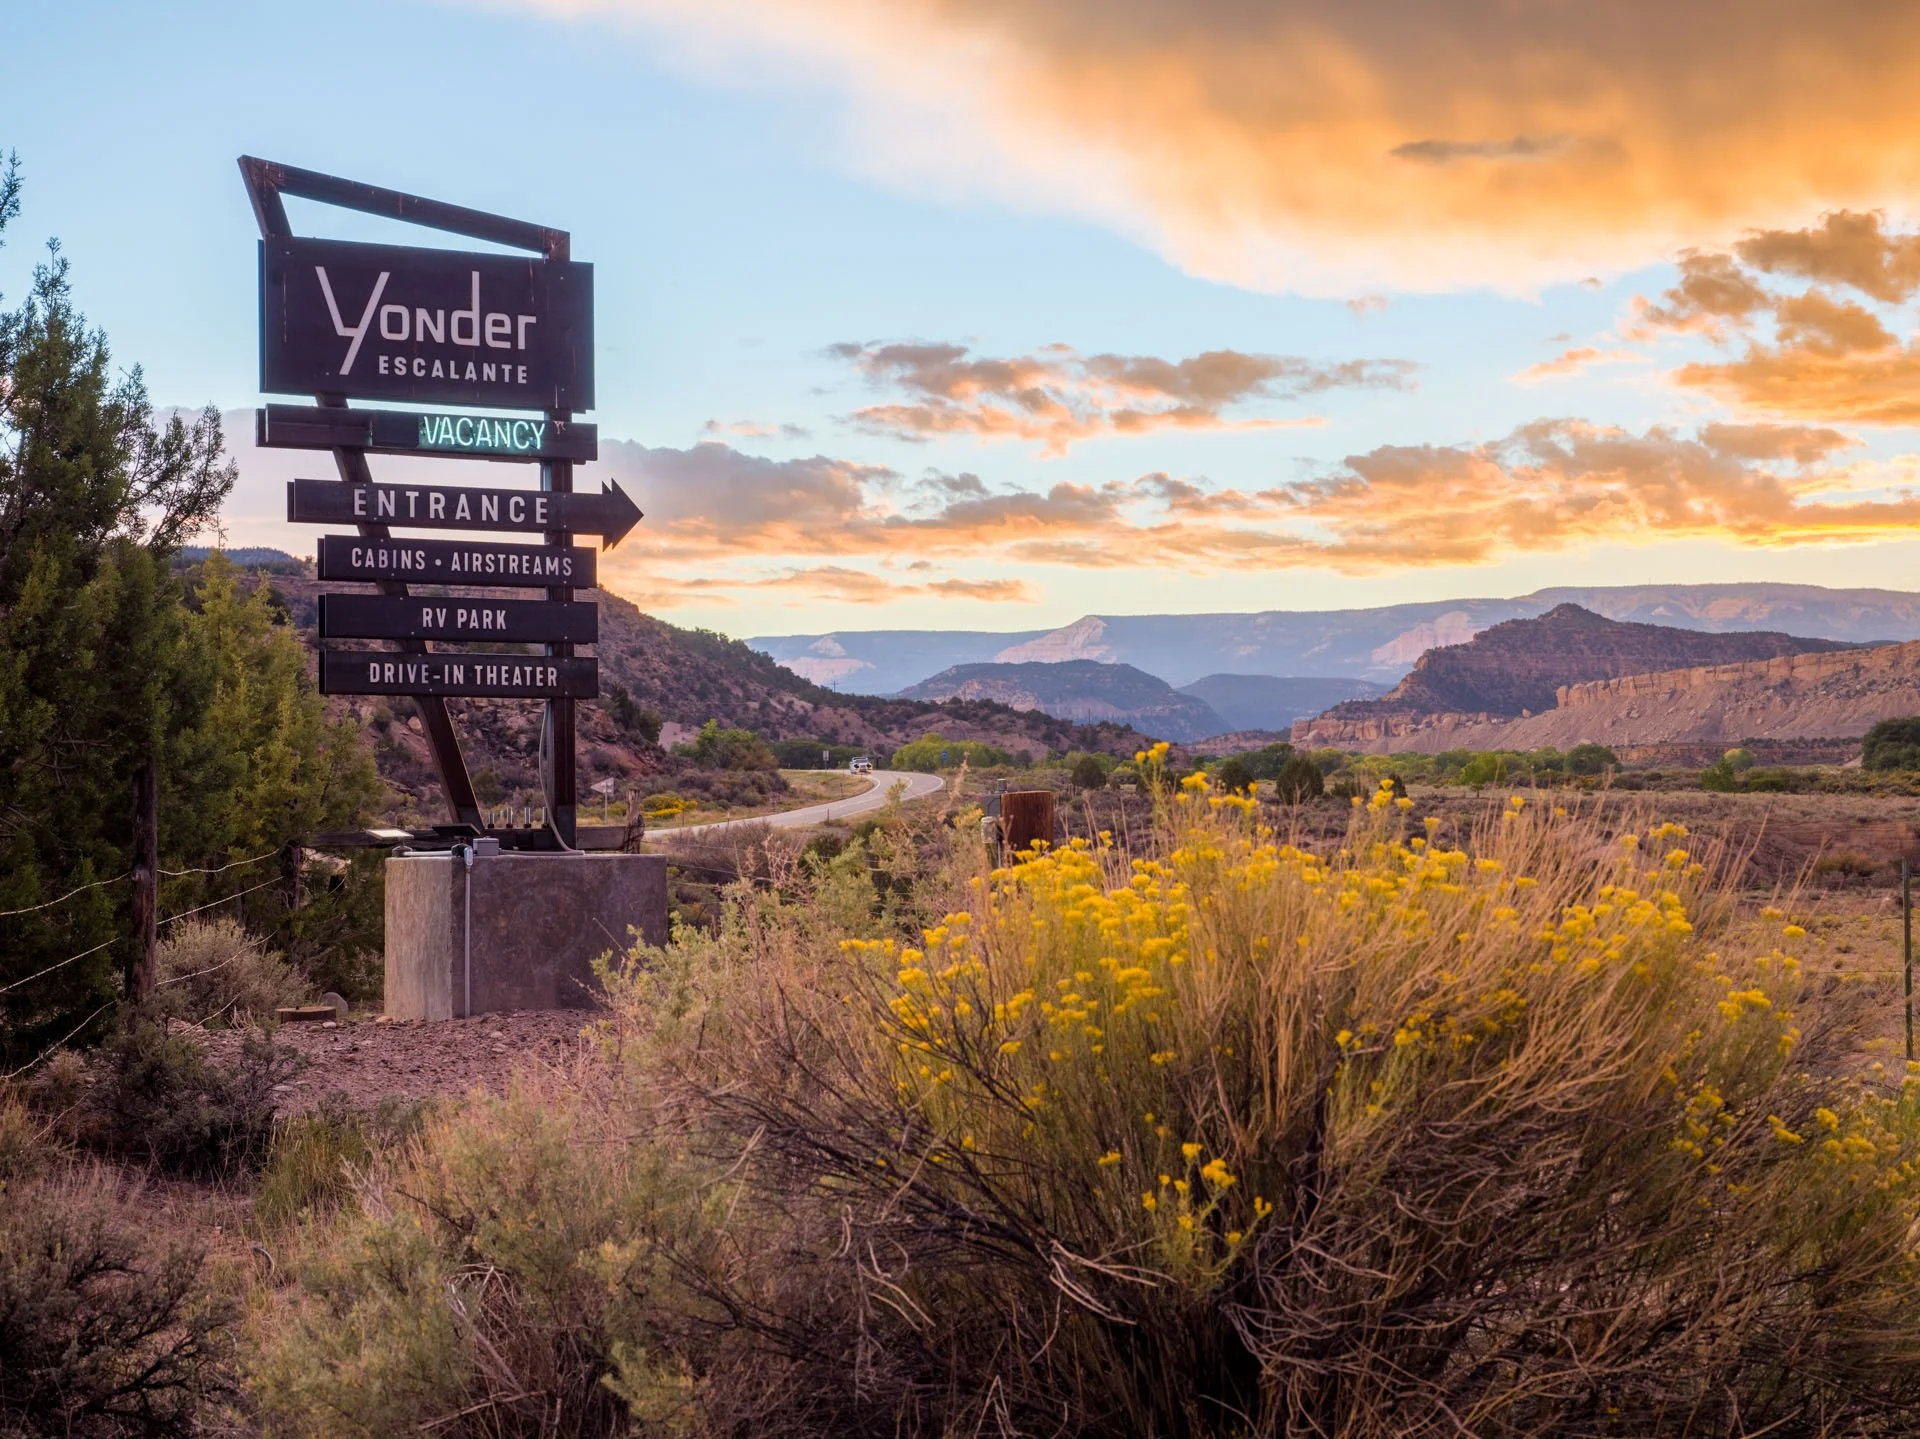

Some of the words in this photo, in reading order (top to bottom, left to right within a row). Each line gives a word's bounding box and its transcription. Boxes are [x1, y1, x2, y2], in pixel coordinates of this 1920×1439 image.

[314, 265, 537, 376] Yonder
[378, 355, 527, 384] ESCALANTE
[423, 416, 546, 450] VACANCY
[353, 488, 548, 524] ENTRANCE
[351, 547, 426, 570] CABINS
[451, 551, 572, 576] AIRSTREAMS
[422, 607, 447, 628] RV
[457, 608, 506, 630] PARK
[369, 662, 464, 685] DRIVE-IN
[474, 665, 557, 687] THEATER
